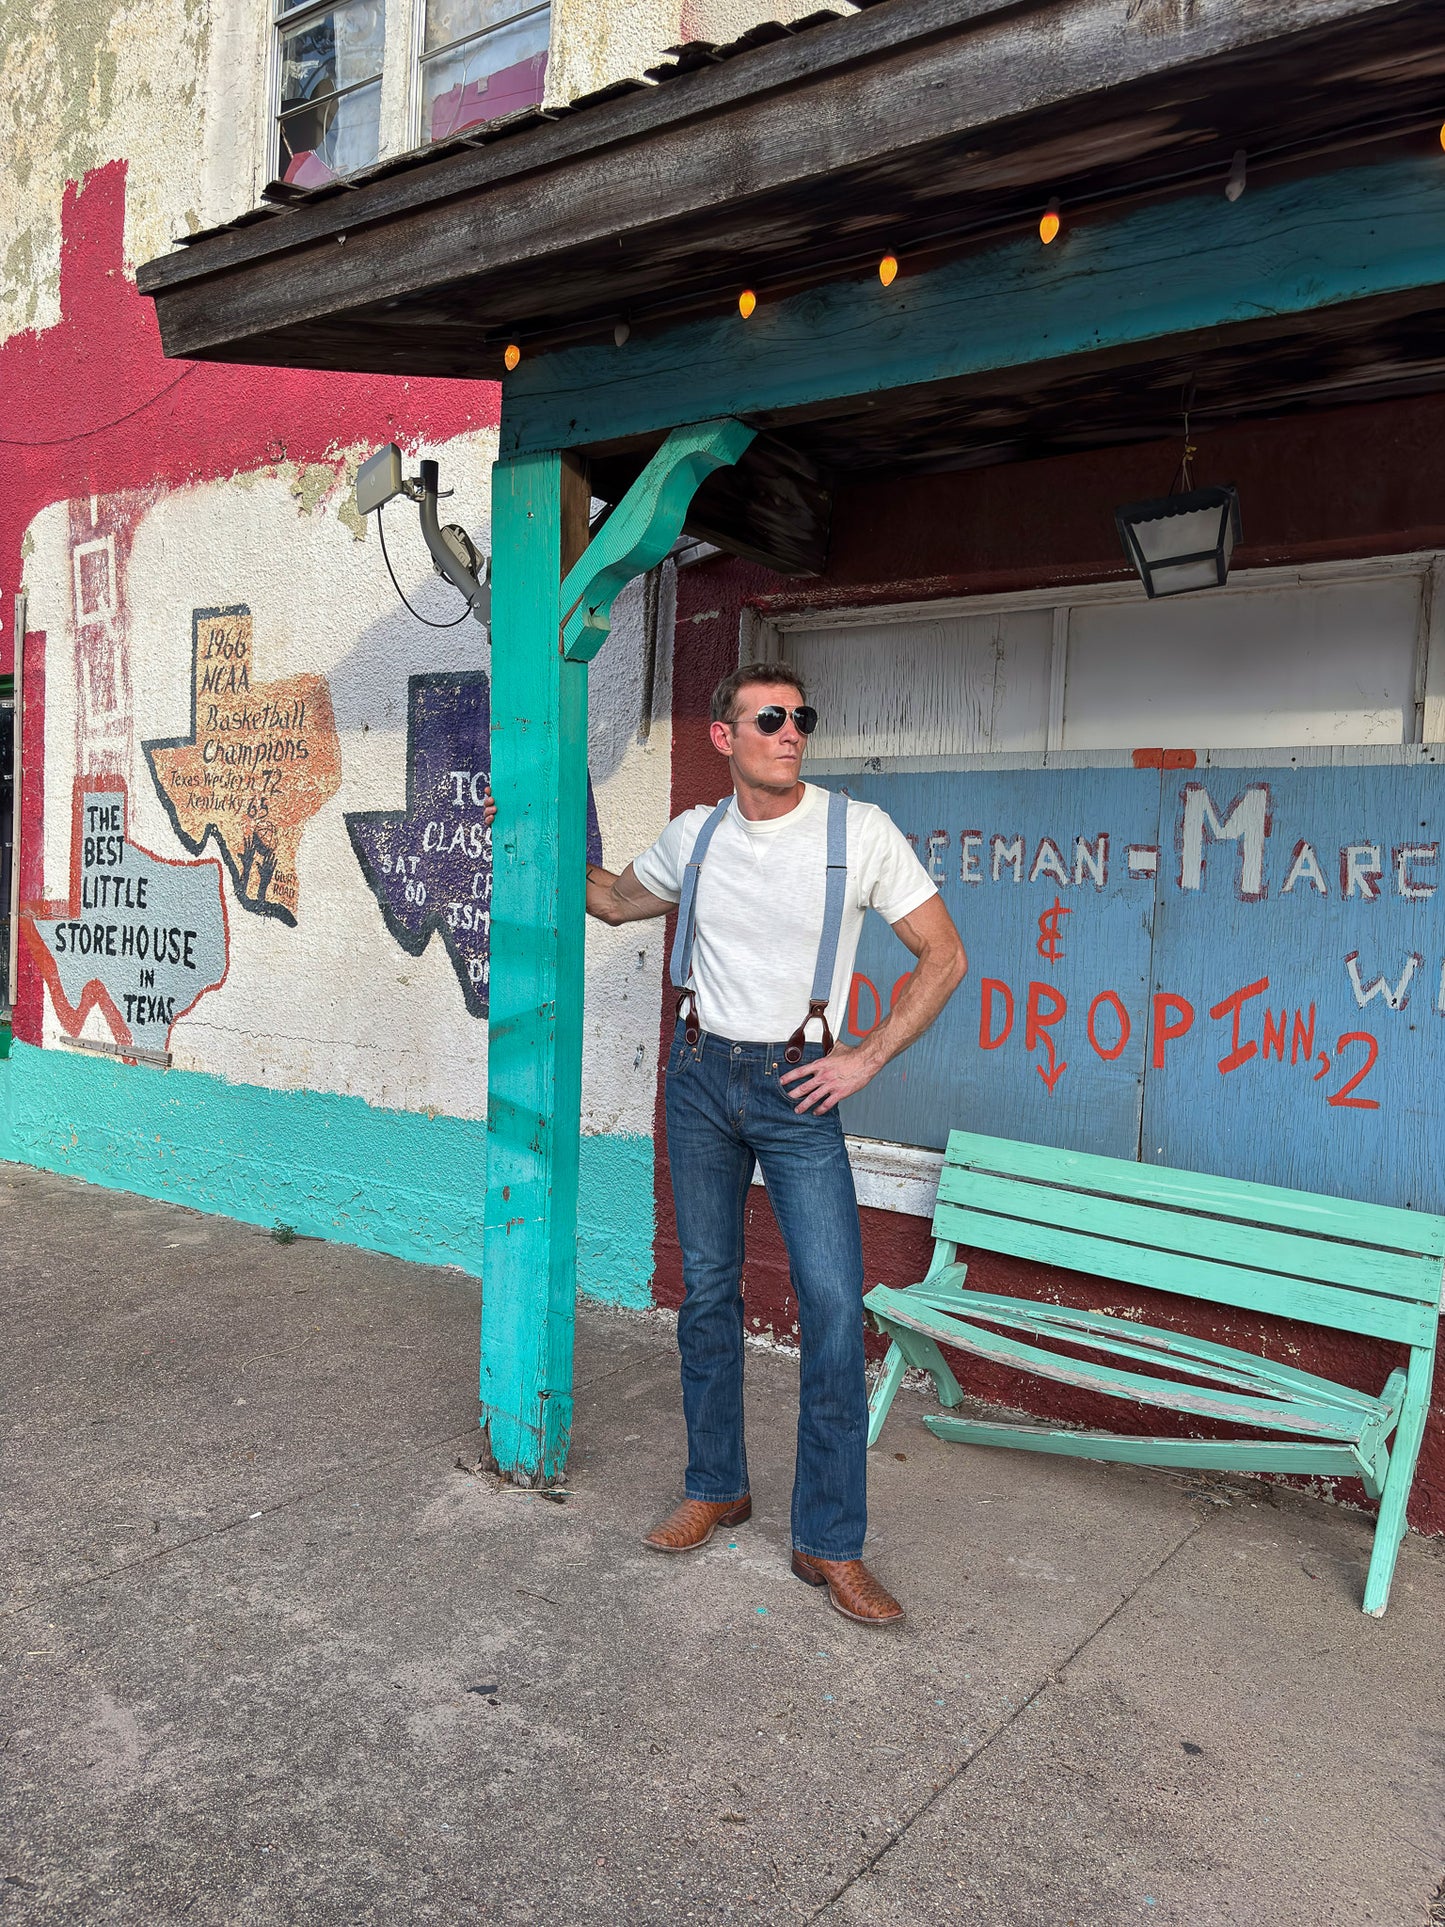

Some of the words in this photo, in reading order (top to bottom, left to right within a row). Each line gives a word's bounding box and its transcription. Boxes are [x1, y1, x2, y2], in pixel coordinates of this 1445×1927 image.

[204, 628, 247, 659] 1966
[201, 664, 250, 694] NCAA
[206, 701, 305, 731] Basketball
[203, 734, 309, 773] Champions
[171, 770, 200, 787] Texas
[262, 768, 284, 796] 72
[450, 771, 491, 806] TC
[87, 805, 120, 832] THE
[247, 795, 268, 820] 65
[84, 836, 124, 867] BEST
[83, 876, 148, 909] LITTLE
[140, 969, 154, 988] IN
[124, 994, 175, 1025] TEXAS
[979, 977, 1195, 1069] DROP
